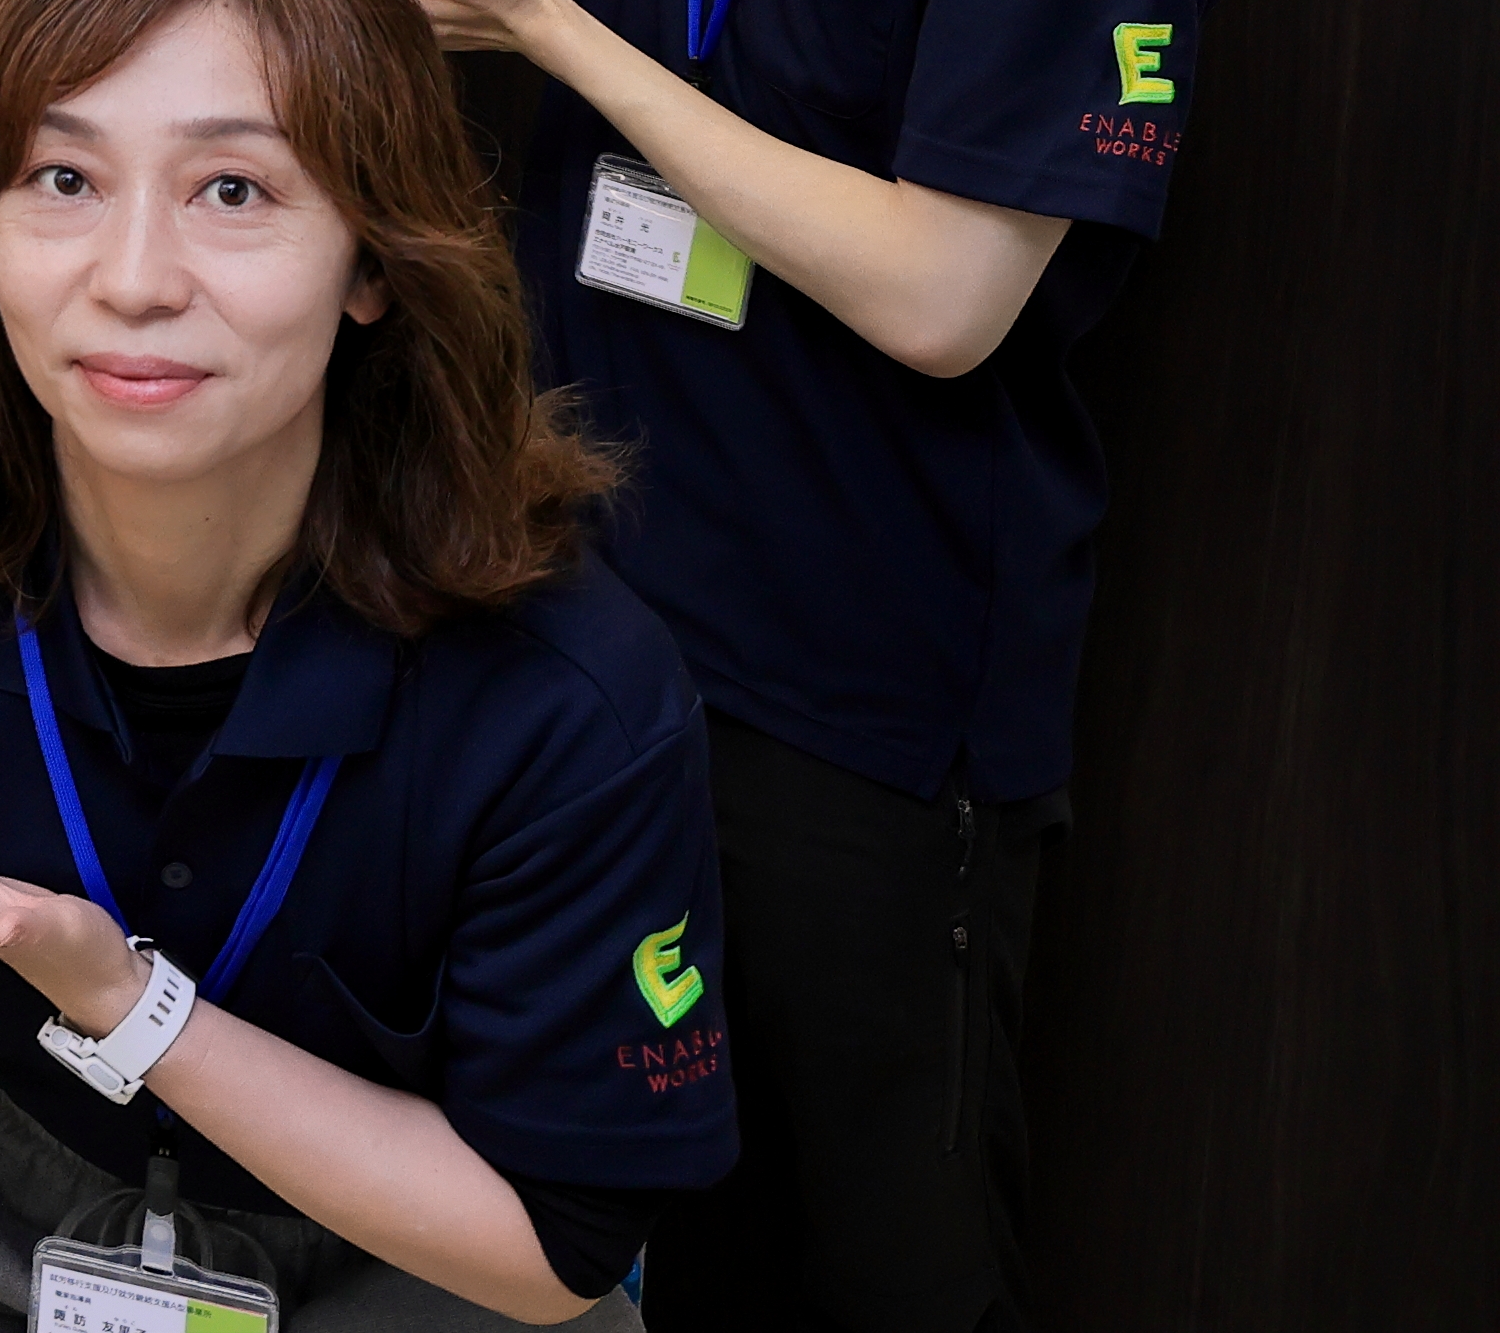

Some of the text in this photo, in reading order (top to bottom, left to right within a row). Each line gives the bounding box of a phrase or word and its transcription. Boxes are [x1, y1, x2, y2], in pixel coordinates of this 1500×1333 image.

[1113, 22, 1176, 106] E
[1094, 137, 1167, 167] WORKS
[632, 909, 705, 1029] E
